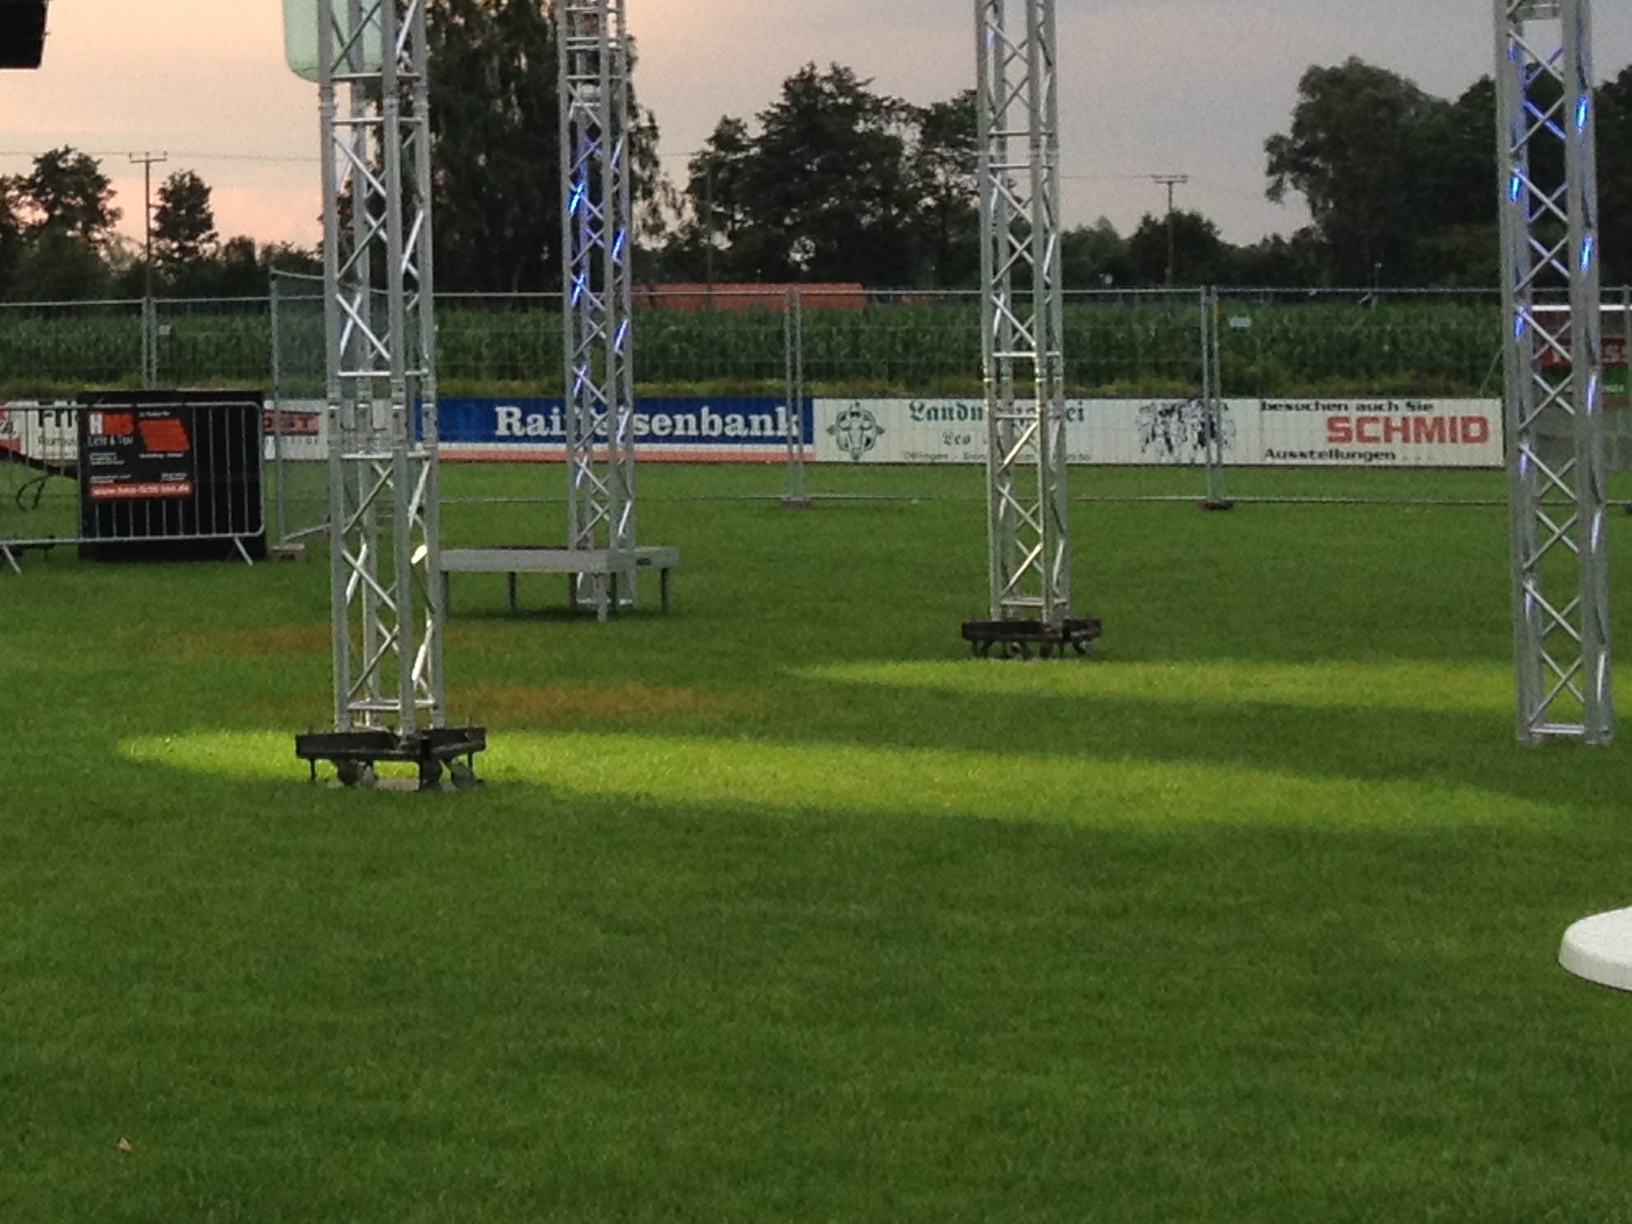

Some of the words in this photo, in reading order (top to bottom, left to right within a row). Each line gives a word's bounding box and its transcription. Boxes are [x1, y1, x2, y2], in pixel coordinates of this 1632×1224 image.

[1261, 400, 1349, 412] besuchen
[1356, 400, 1399, 412] auch
[1406, 400, 1434, 412] Sie
[1326, 416, 1490, 444] SCHMID
[1264, 448, 1397, 461] Ausstellungen
